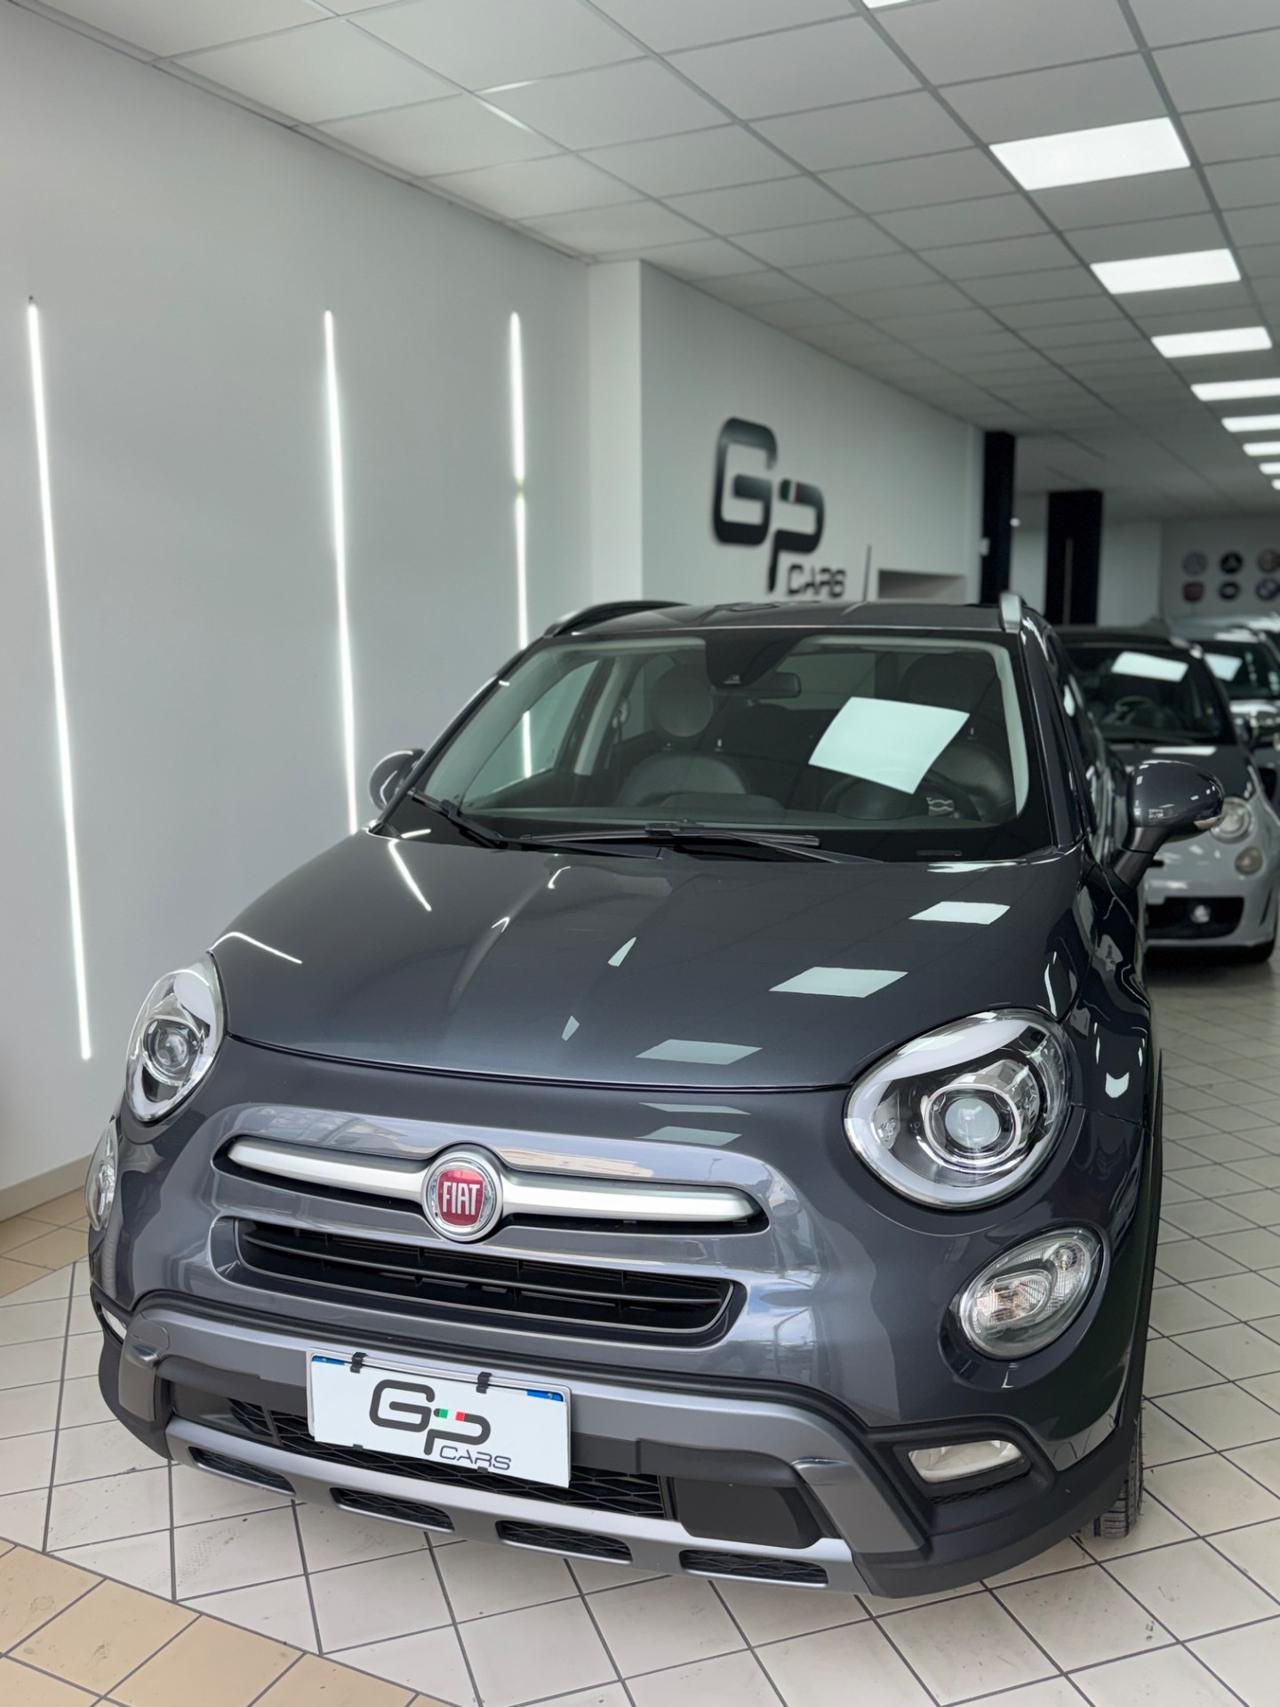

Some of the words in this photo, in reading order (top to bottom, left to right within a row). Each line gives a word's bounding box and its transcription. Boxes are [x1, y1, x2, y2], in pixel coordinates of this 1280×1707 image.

[712, 416, 825, 594] GP
[786, 563, 847, 598] CARS
[442, 1181, 480, 1216] FIAT
[369, 1379, 491, 1456] GP
[439, 1445, 512, 1471] CARS
